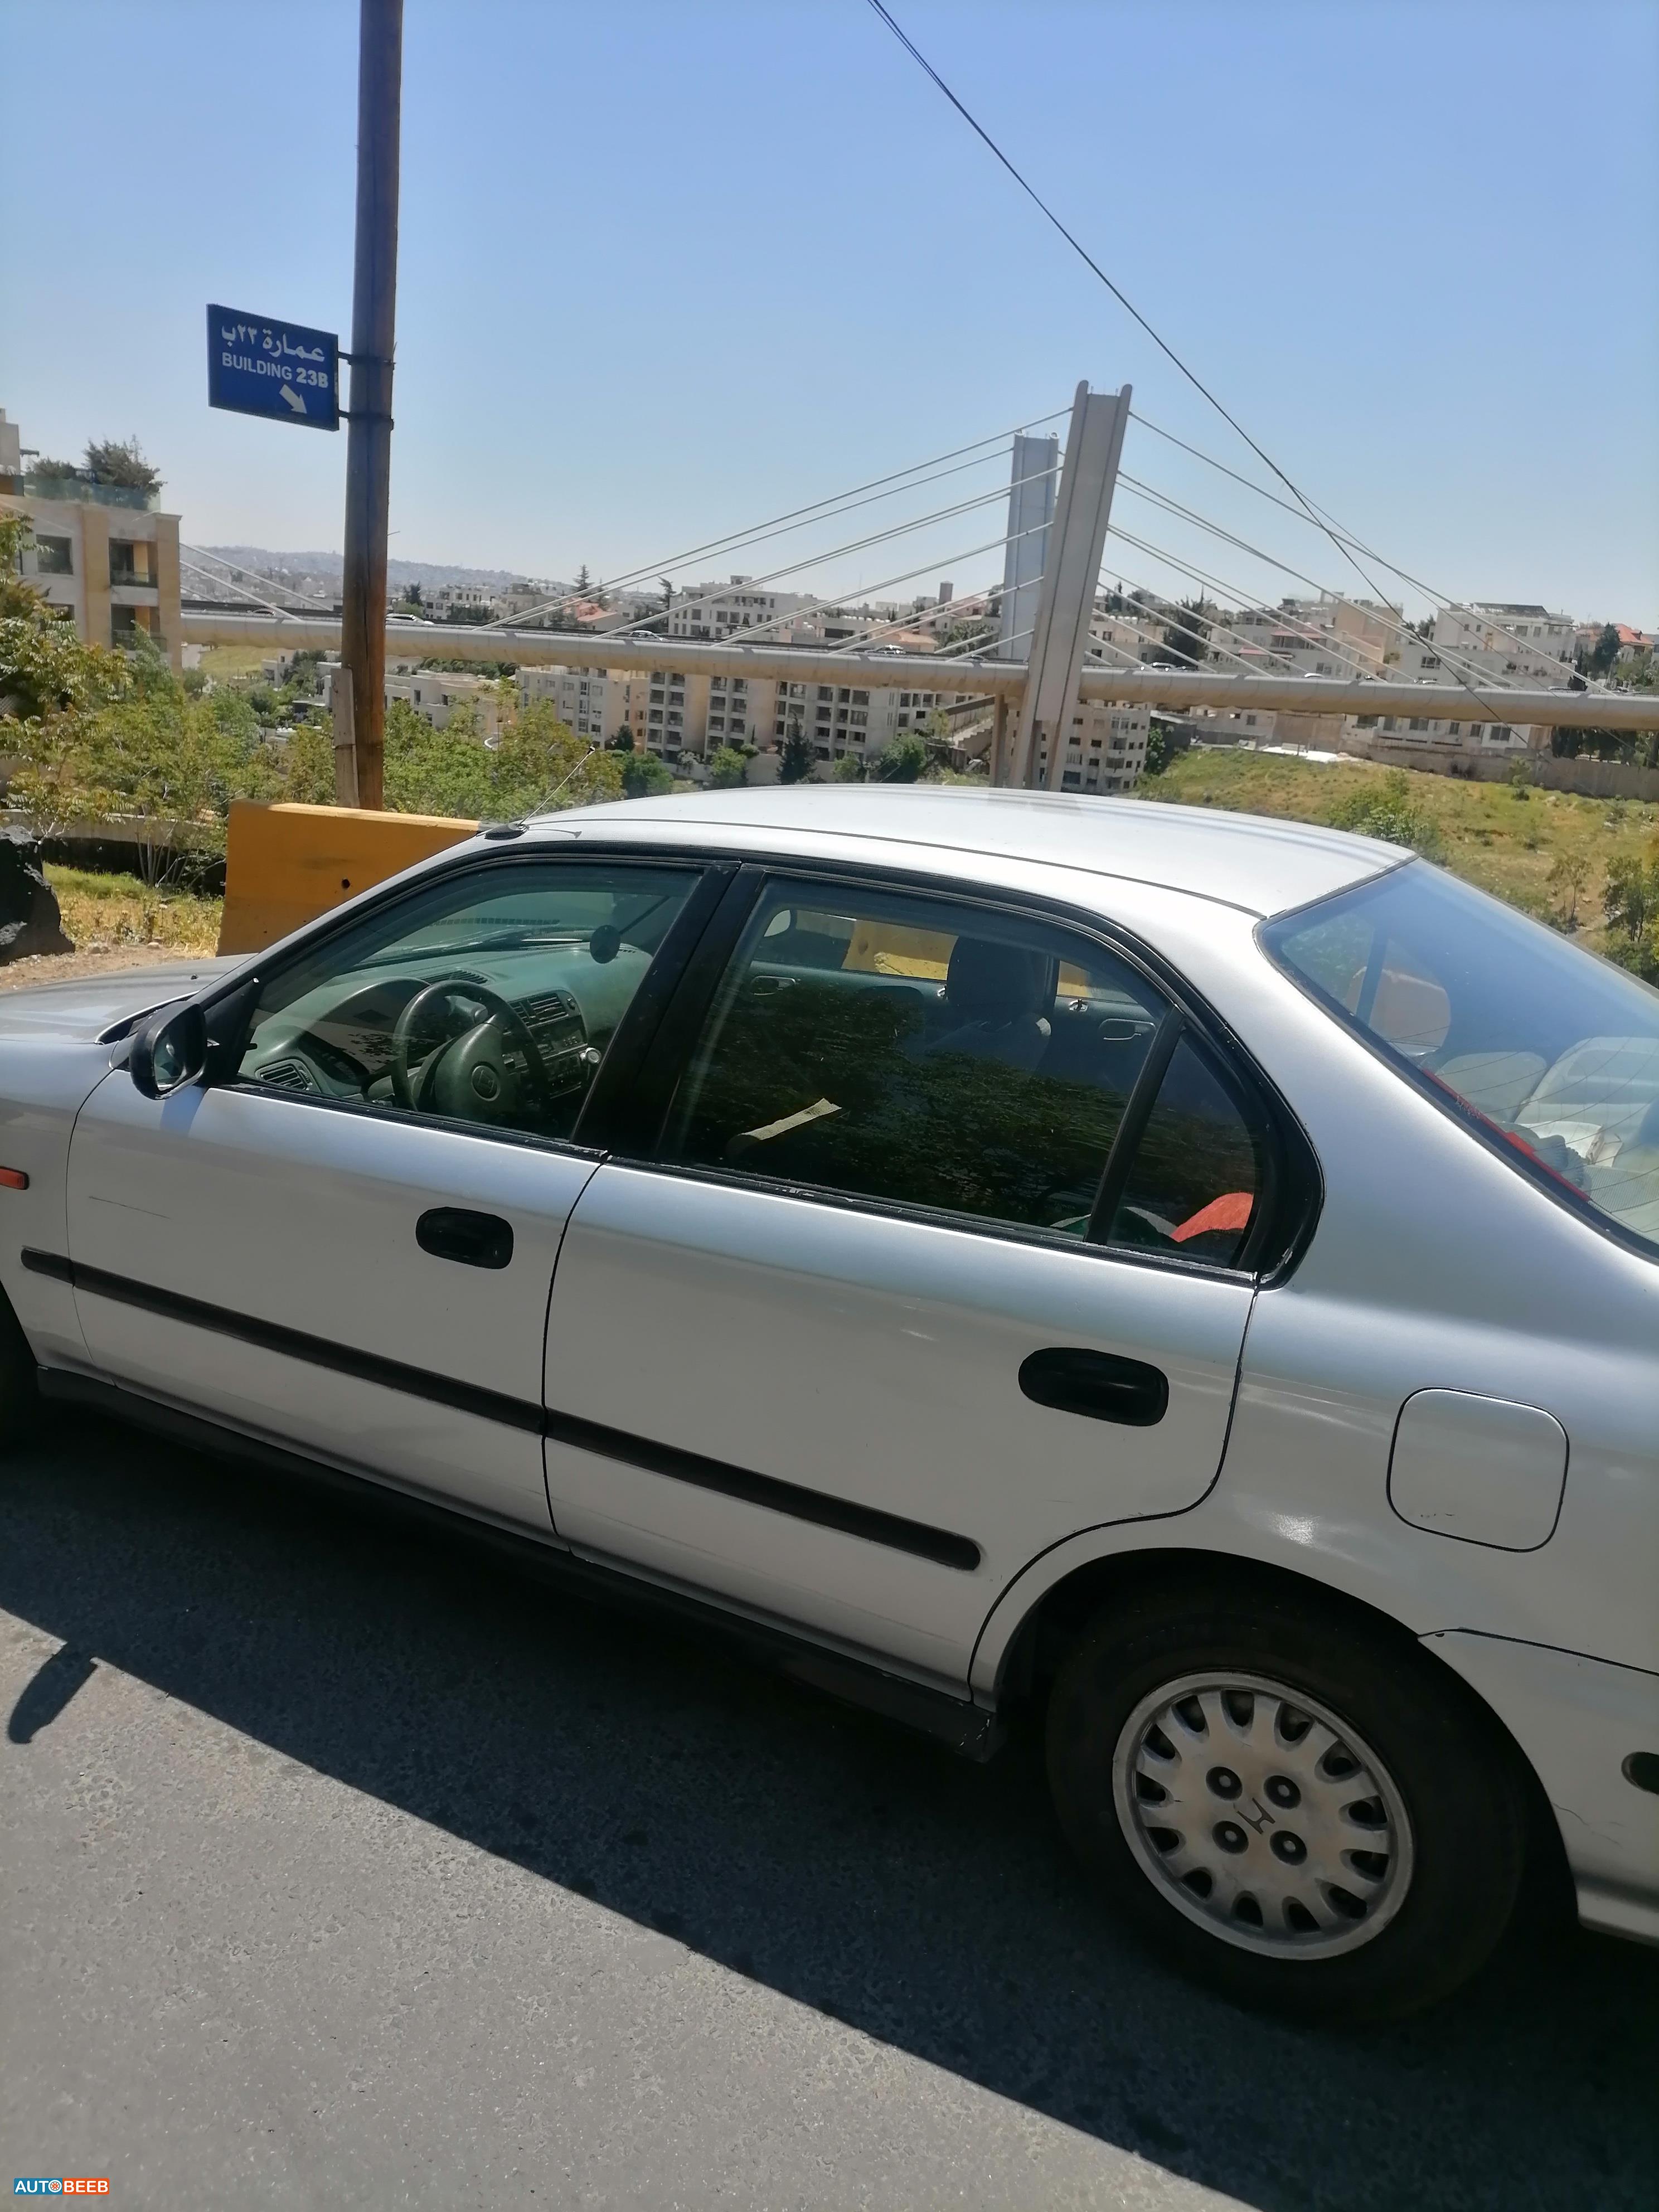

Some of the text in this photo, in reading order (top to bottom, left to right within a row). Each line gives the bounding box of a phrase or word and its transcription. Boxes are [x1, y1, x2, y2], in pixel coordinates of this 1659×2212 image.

[262, 328, 325, 362] عمارة
[222, 352, 328, 388] BUILDING 23B
